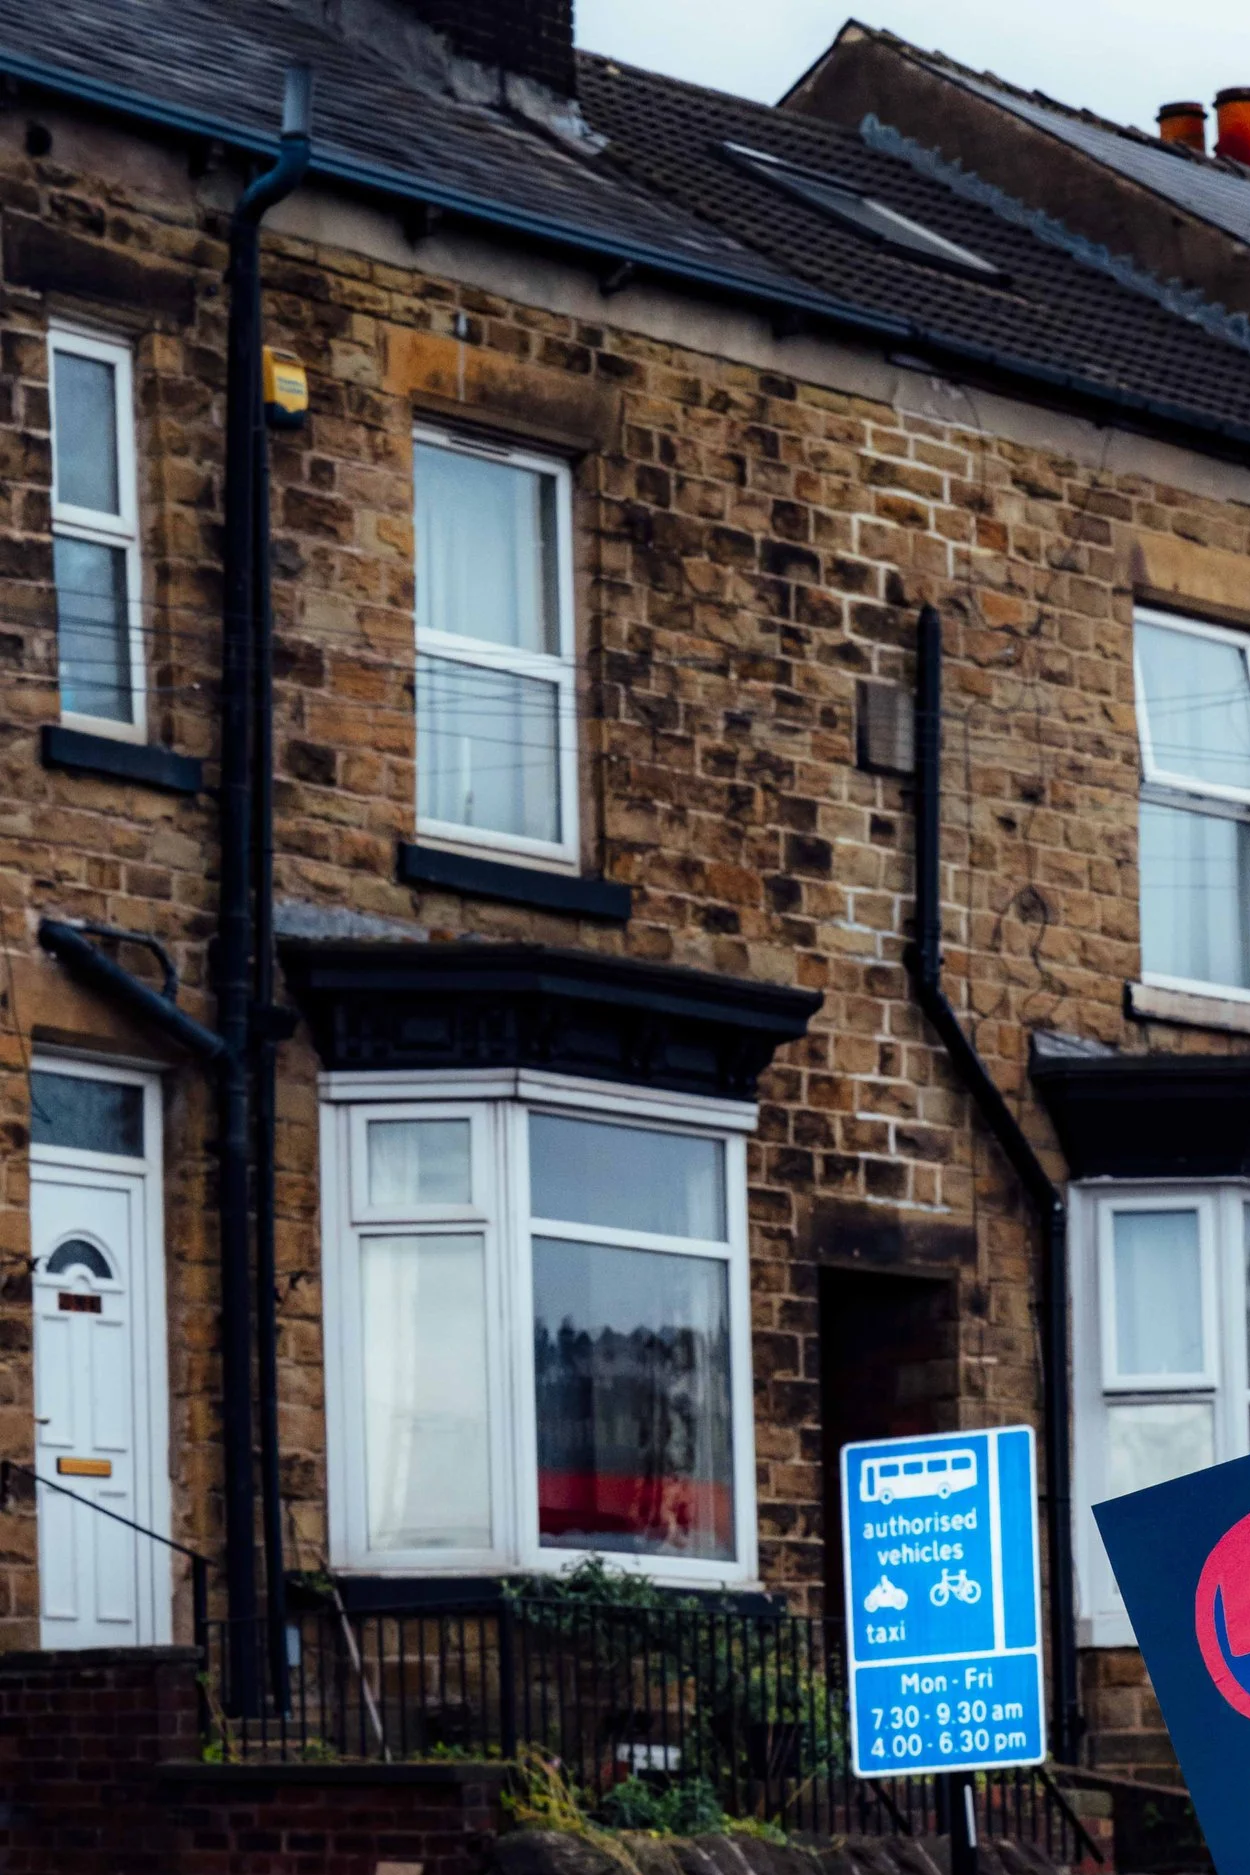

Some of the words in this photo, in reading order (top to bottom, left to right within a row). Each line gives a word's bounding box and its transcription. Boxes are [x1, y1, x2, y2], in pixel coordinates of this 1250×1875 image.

[863, 1507, 977, 1539] authorised
[877, 1540, 964, 1566] vehicles
[866, 1620, 906, 1644] taxi
[901, 1672, 947, 1695] Mon
[965, 1666, 993, 1690] Fri
[871, 1705, 920, 1730] 7.30
[936, 1700, 987, 1725] 9.30
[992, 1702, 1023, 1721] am
[871, 1733, 922, 1758] 4.00
[939, 1728, 989, 1754] 6.30
[994, 1731, 1027, 1754] pm
